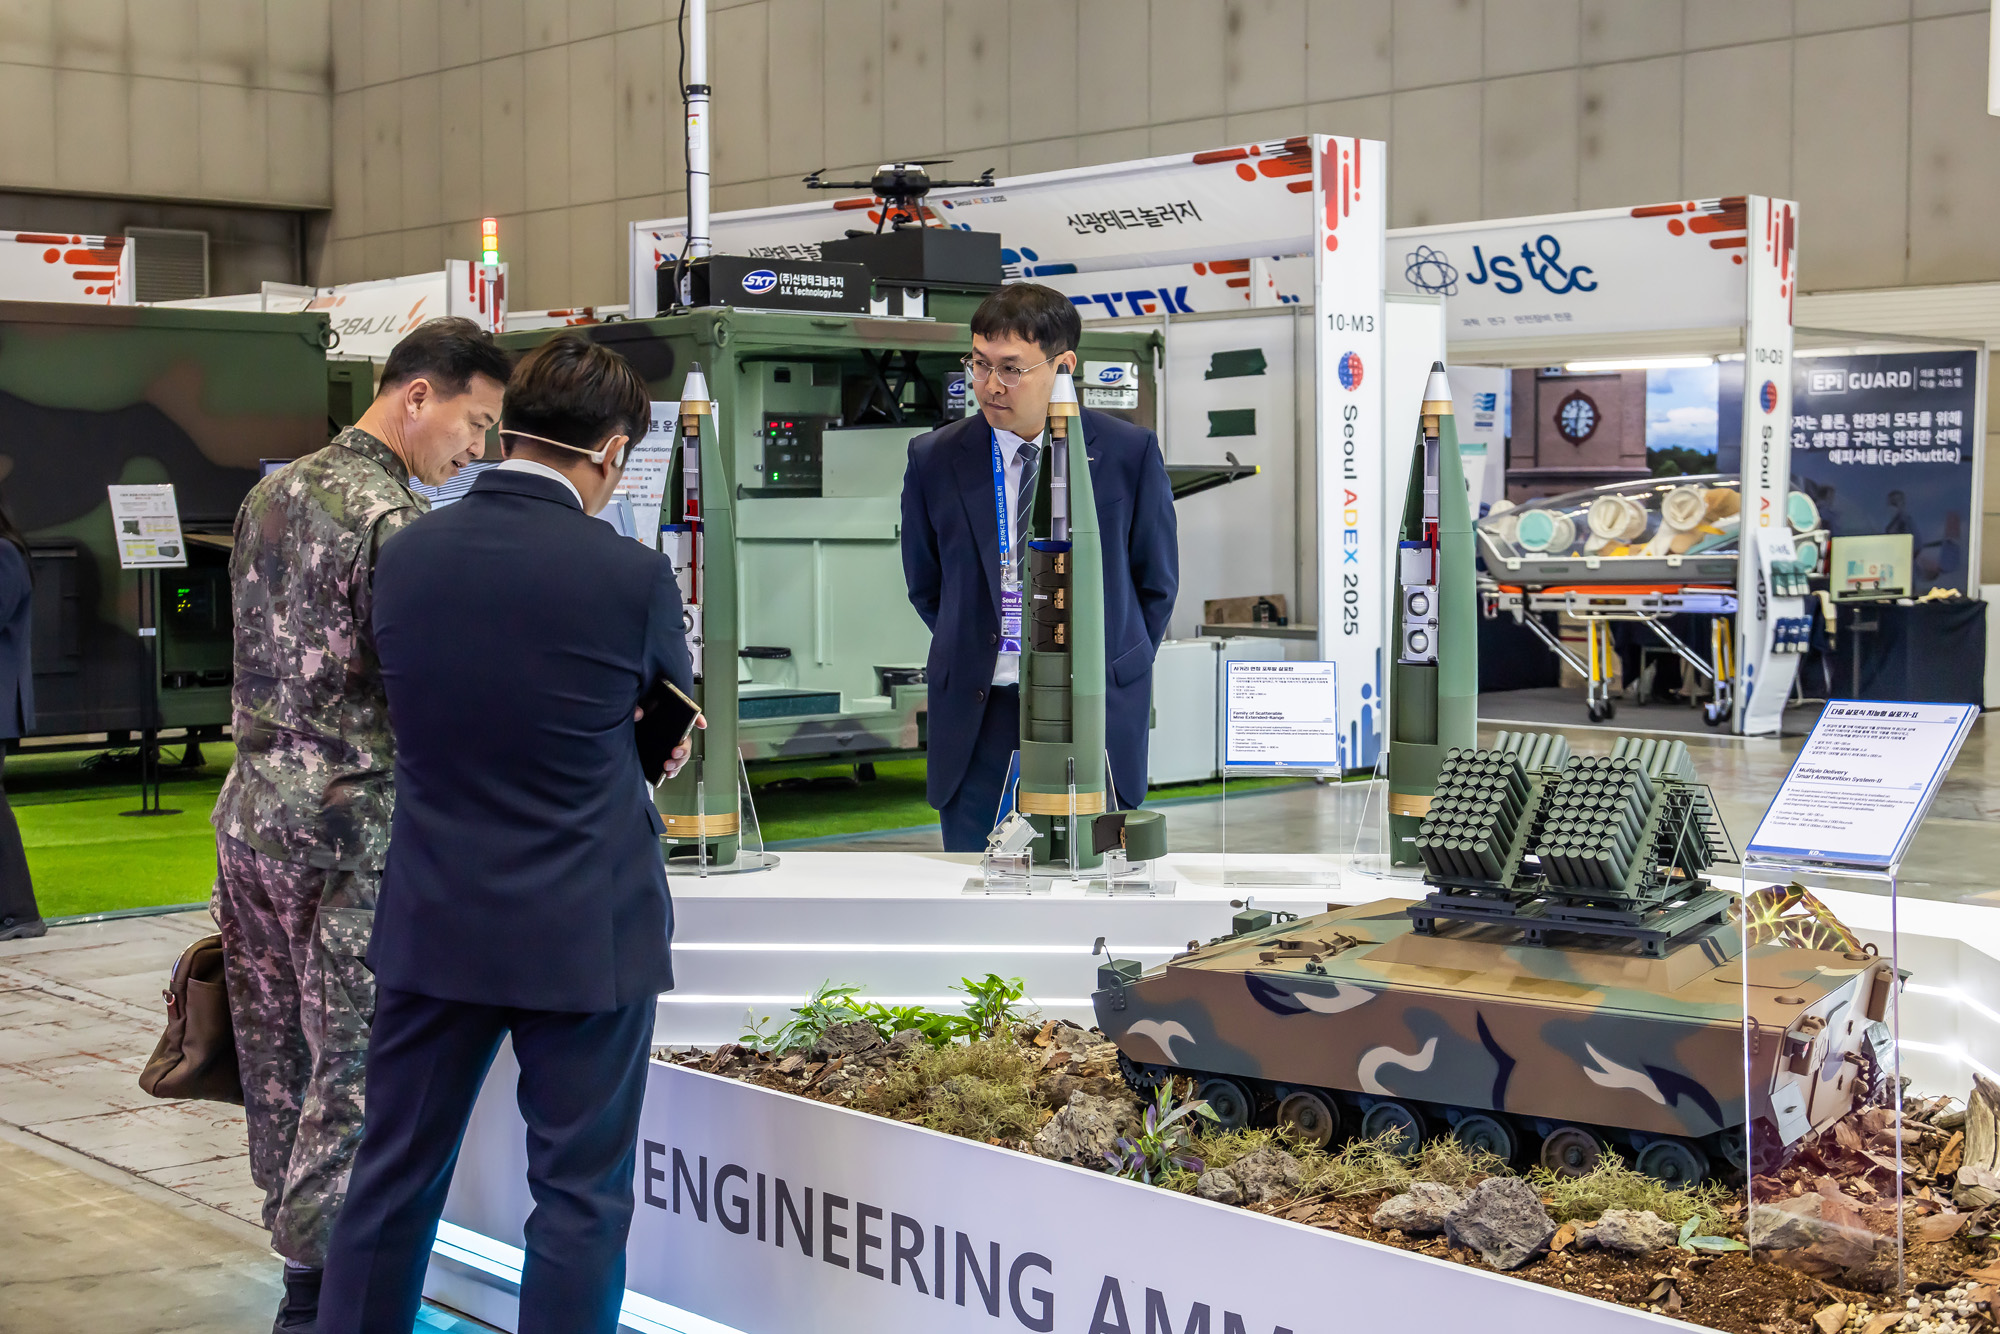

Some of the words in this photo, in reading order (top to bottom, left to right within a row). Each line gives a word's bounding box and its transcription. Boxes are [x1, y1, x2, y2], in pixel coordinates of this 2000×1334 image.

[1067, 200, 1203, 234] 신광테크놀러지
[744, 275, 778, 287] SKT
[1327, 313, 1375, 333] 10-M3
[1848, 371, 1912, 390] GUARD
[1791, 415, 1819, 430] 자는
[1852, 412, 1891, 429] 현장의
[1893, 411, 1932, 427] 모두를
[1935, 410, 1964, 427] 위해
[1343, 404, 1358, 480] Seoul
[1812, 432, 1849, 448] 생명을
[1852, 431, 1891, 446] 구하는
[1935, 429, 1963, 446] 선택
[1761, 425, 1773, 489] Seoul
[1343, 488, 1358, 565] ADEX
[1343, 573, 1359, 636] 2025
[643, 1138, 1054, 1333] ENGINEERING
